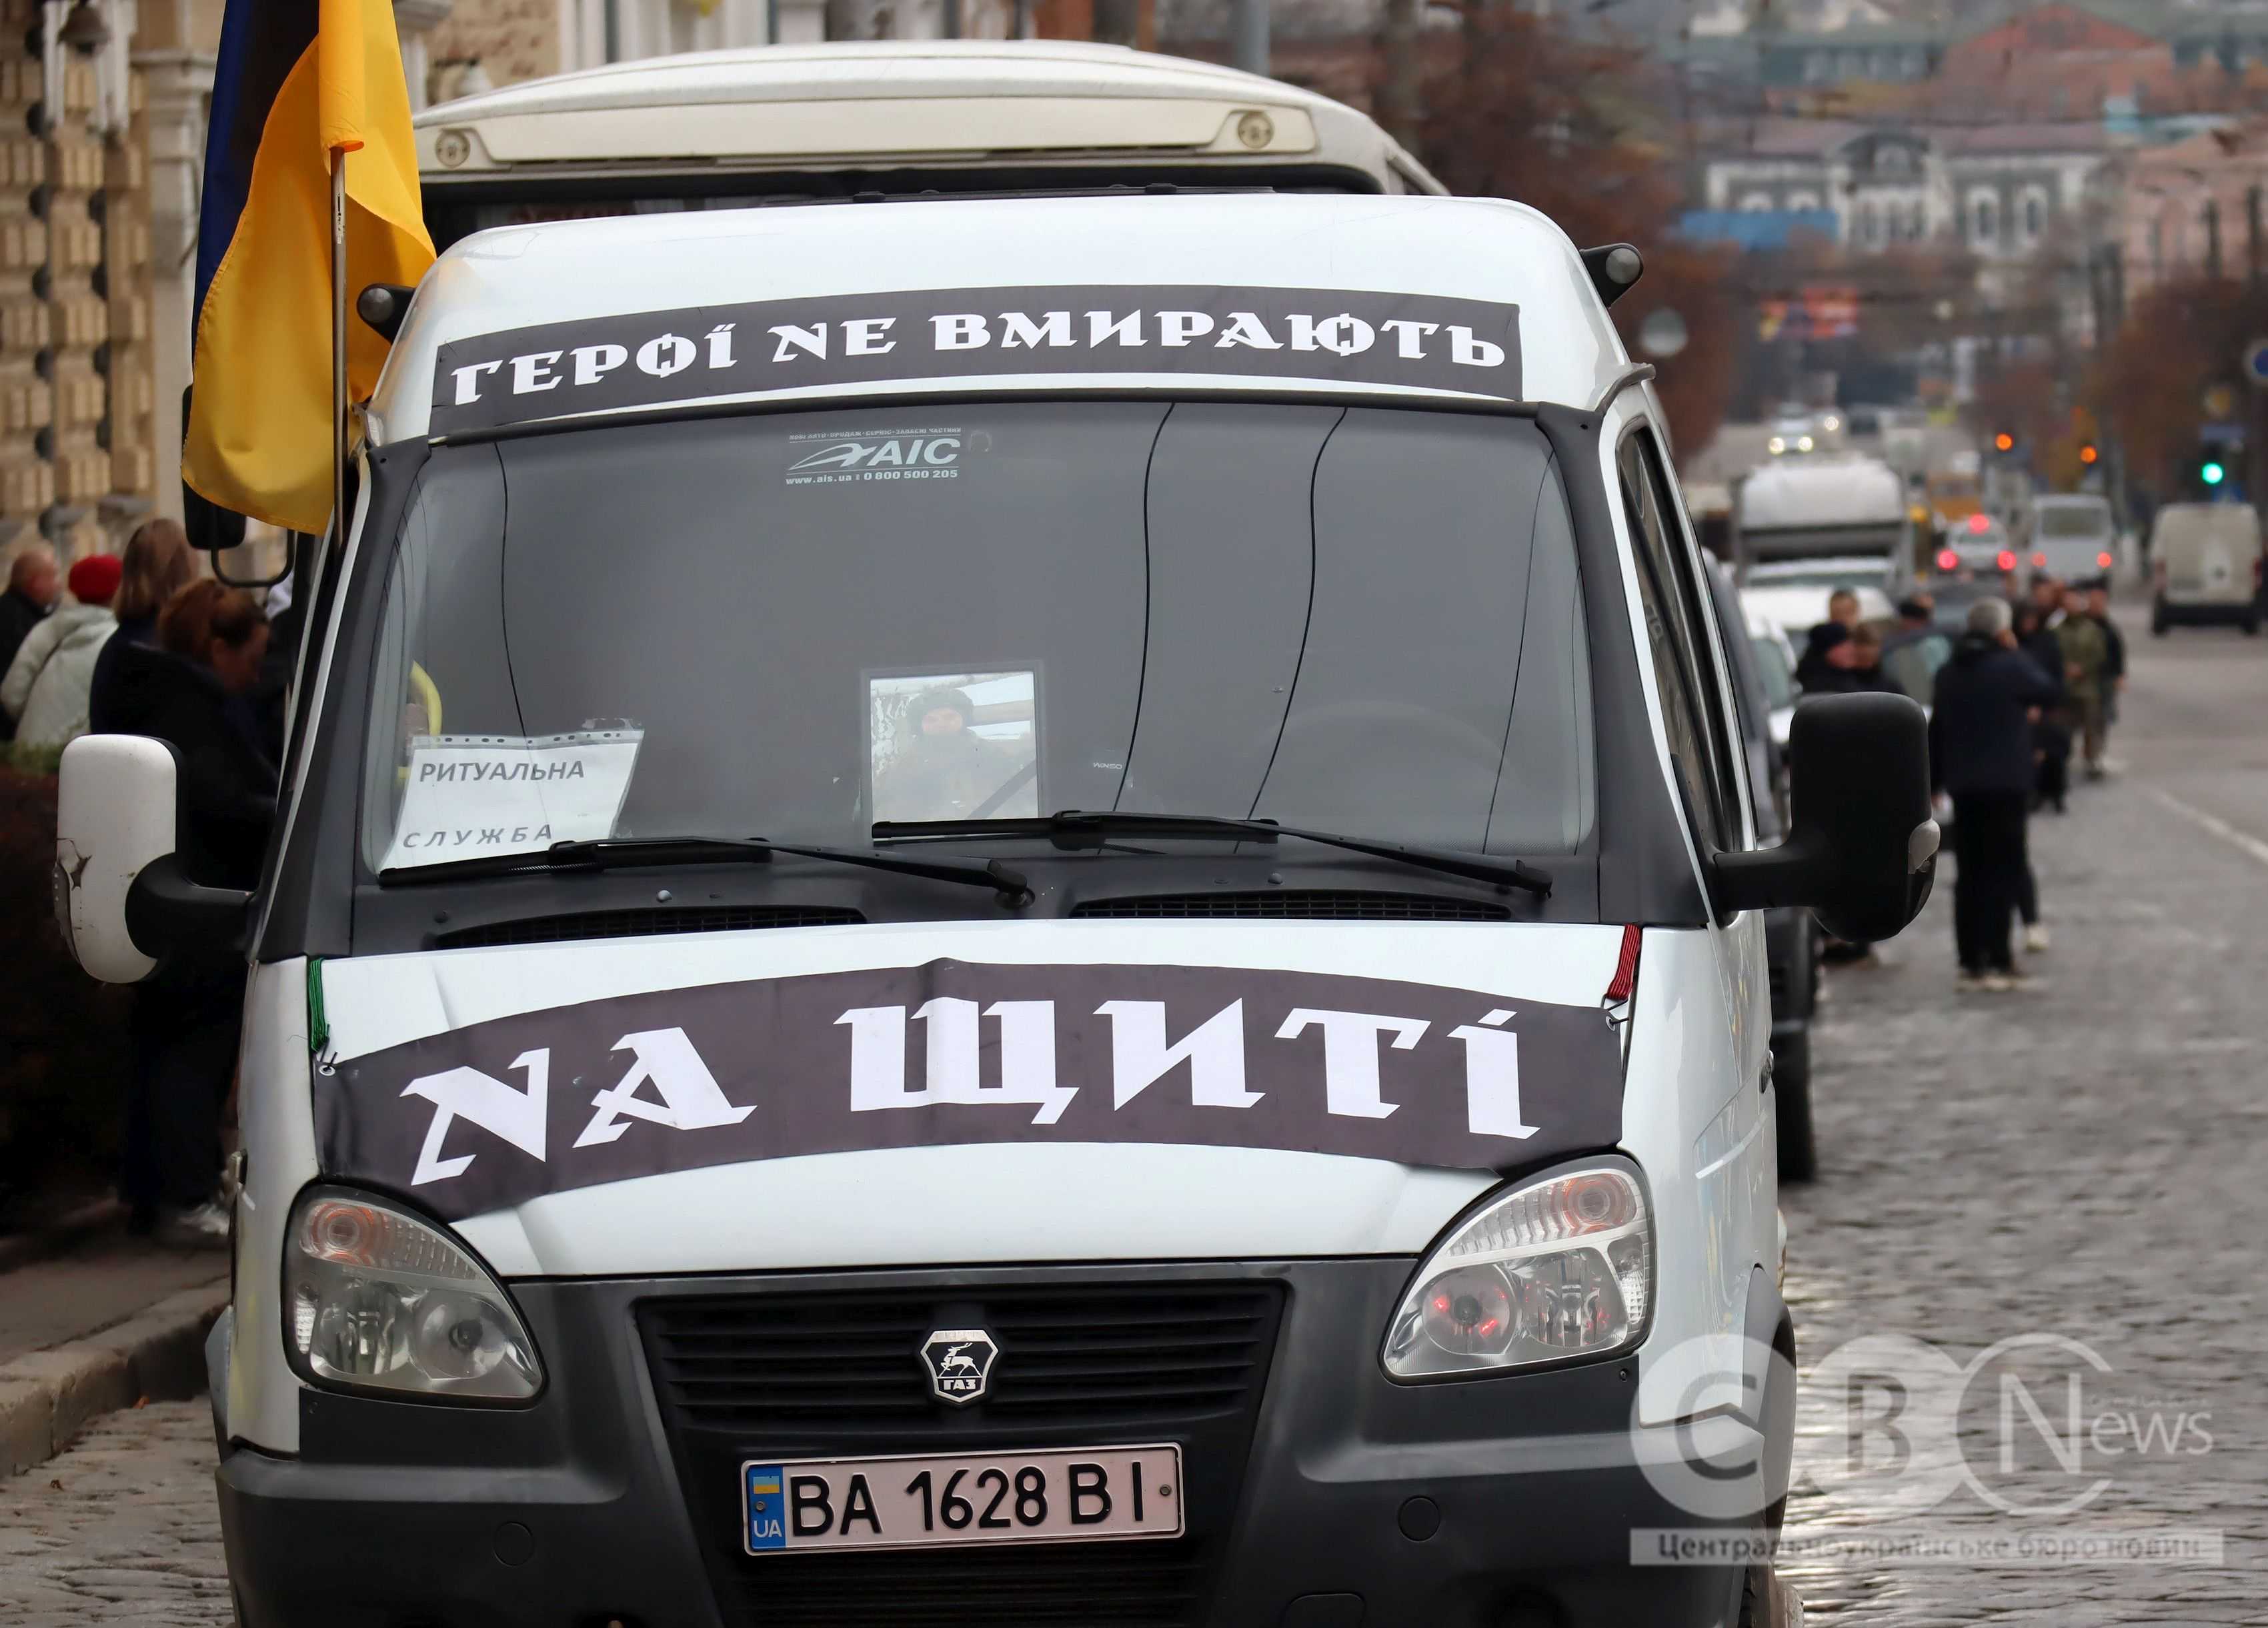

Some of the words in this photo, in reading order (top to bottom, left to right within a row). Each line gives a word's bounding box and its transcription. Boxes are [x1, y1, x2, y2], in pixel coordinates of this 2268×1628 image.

[450, 323, 737, 405] ГЕРОЇ
[928, 309, 1506, 367] ВМИРАЮТЬ
[786, 474, 852, 485] www.ais.ua
[875, 471, 900, 480] 800
[904, 470, 929, 480] 500
[932, 470, 958, 478] 205
[419, 760, 585, 782] РИТУАЛЬНА
[403, 824, 552, 848] СЛУЖБА
[833, 996, 1541, 1139] ЩИТІ
[943, 1379, 976, 1391] ГАЗ
[753, 1519, 783, 1538] UA
[905, 1465, 1049, 1531] 1628
